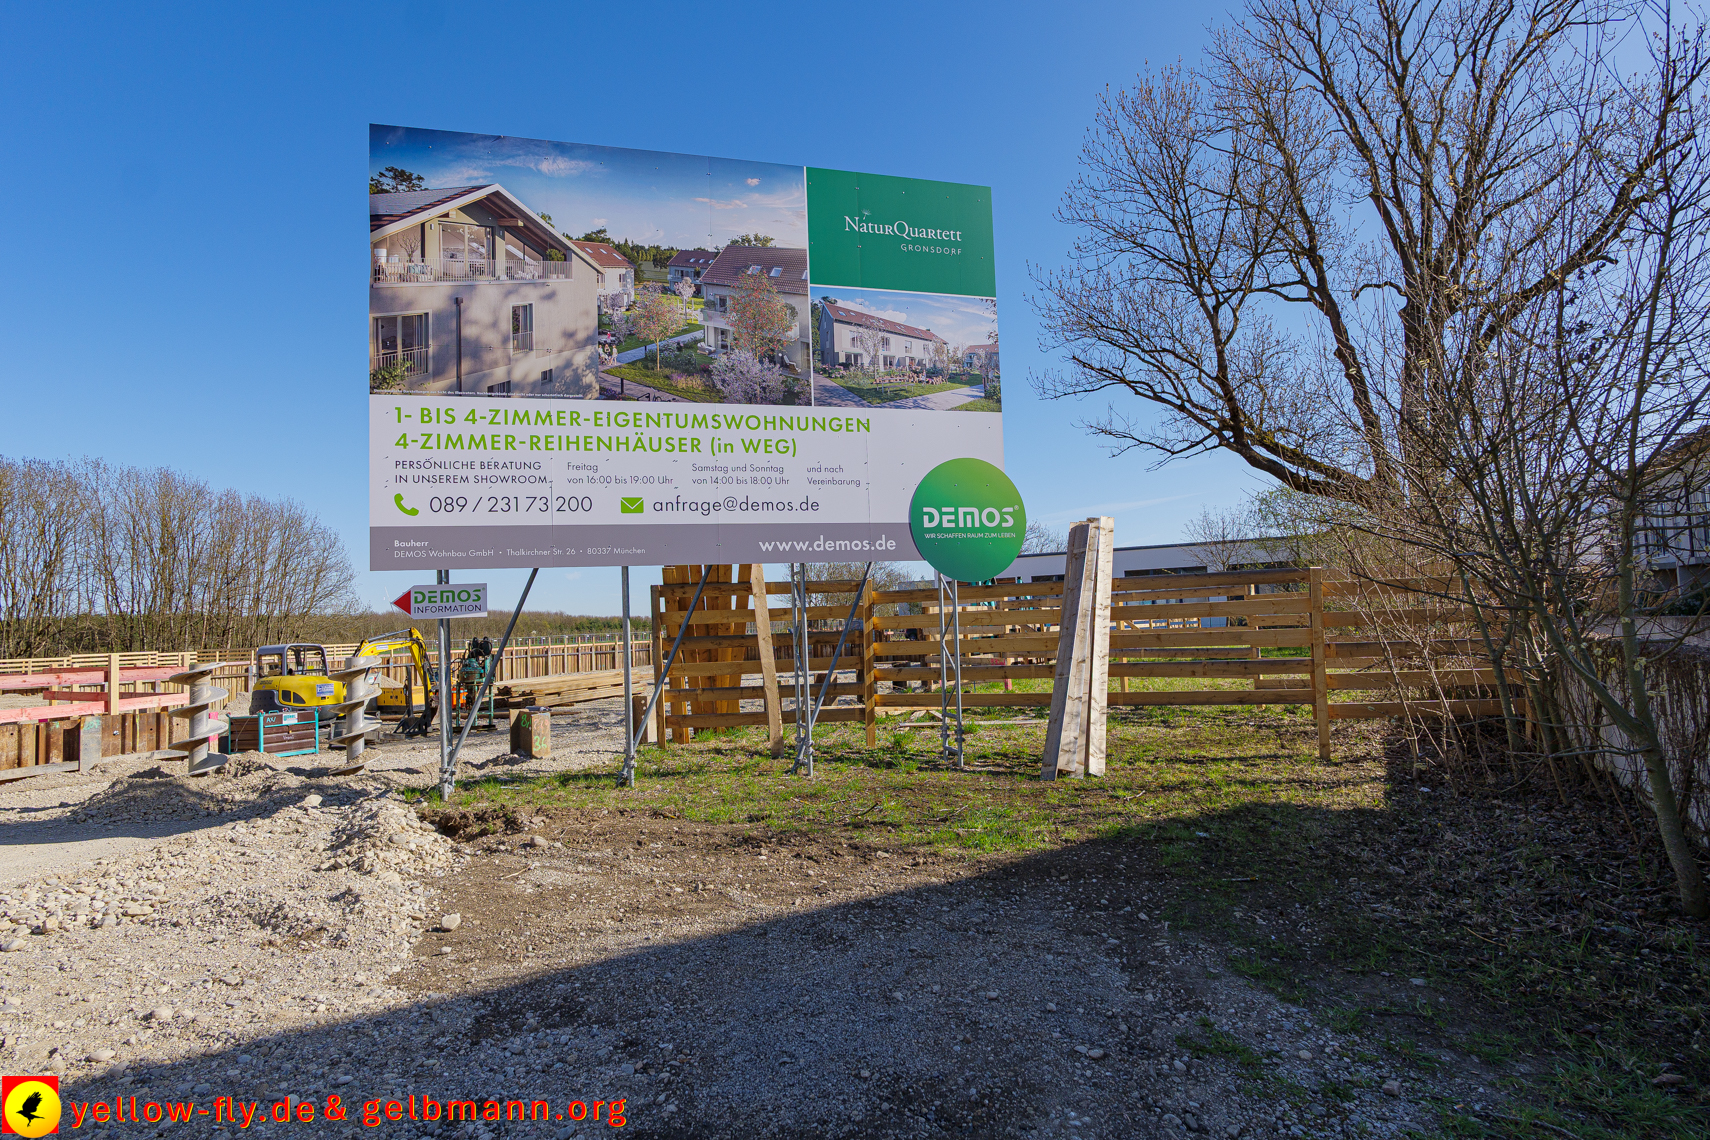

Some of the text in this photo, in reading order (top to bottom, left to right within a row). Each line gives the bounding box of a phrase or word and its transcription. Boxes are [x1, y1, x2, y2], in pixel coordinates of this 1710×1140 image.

[900, 243, 962, 255] GRONSDORF
[395, 407, 871, 433] 1- BIS 4-ZIMMER-EIGENTUMSWOHNUNGEN
[395, 432, 797, 457] 4-ZIMMER-REIHENHÄUSER (in WEG)
[395, 459, 542, 470] PERSÖNLICHE BERATUNG
[567, 462, 598, 473] Freitag
[692, 463, 784, 475] Samstag und Sonntag
[807, 465, 844, 474] und nach
[395, 475, 547, 484] IN UNSEREM SHOWROOM
[586, 475, 612, 485] 16:00
[614, 475, 628, 485] bis
[629, 476, 655, 485] 19:00
[657, 476, 674, 485] Uhr
[710, 476, 734, 485] 14:00
[736, 476, 748, 485] bis
[749, 476, 773, 485] 18:00
[774, 477, 790, 485] Uhr
[807, 477, 861, 487] Vereinbarung
[429, 496, 468, 513] 089
[555, 496, 593, 513] 200
[653, 495, 820, 516] anfrage@demos.de
[394, 539, 429, 547] Bauherr
[759, 534, 897, 552] www.demos.de
[394, 550, 427, 558] DEMOS
[429, 550, 467, 558] Wohnbau
[468, 549, 494, 557] GmbH
[506, 548, 551, 557] Thalkirchner
[552, 548, 565, 556] Str.
[587, 547, 611, 555] 80337
[613, 546, 646, 555] München
[414, 604, 482, 614] INFORMATION
